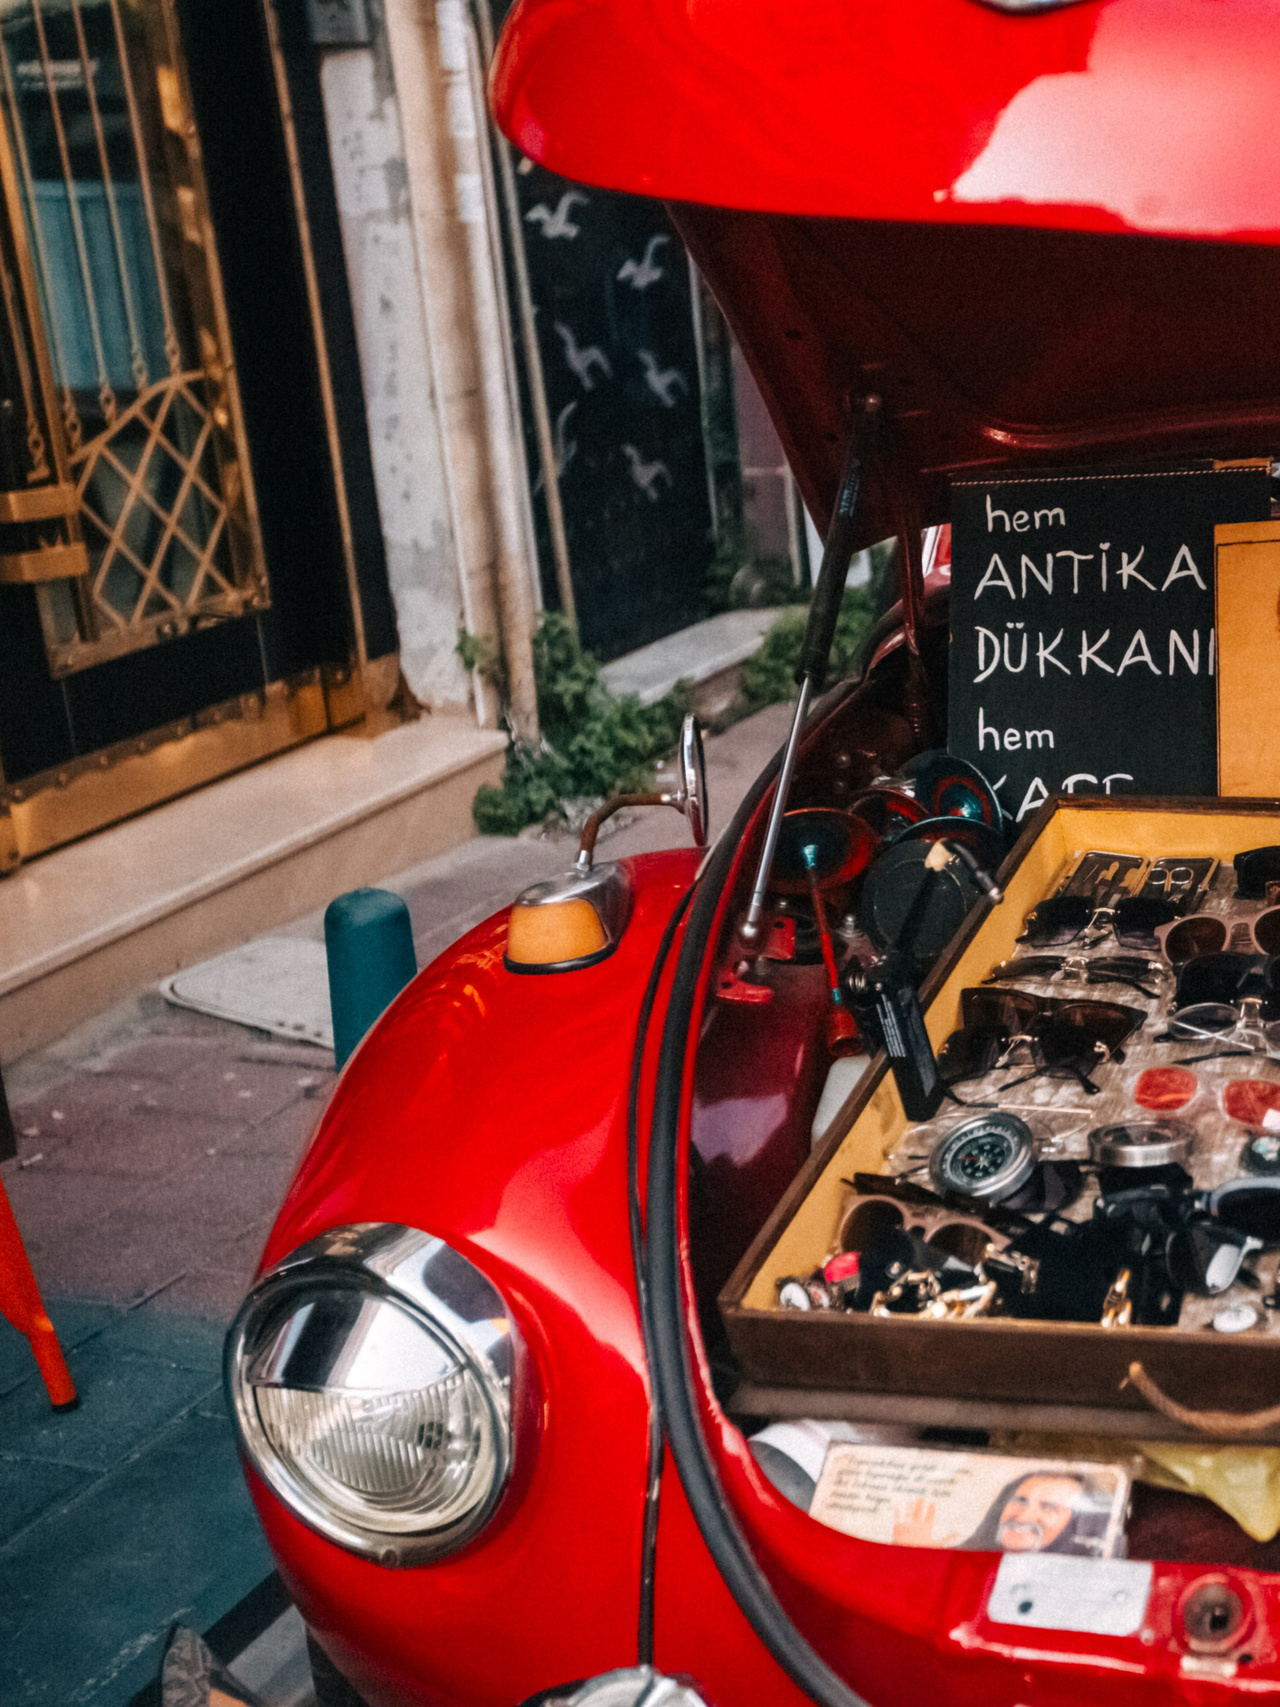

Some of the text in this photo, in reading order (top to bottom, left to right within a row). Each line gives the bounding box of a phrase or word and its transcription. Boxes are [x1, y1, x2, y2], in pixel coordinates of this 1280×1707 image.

[986, 494, 1066, 532] hem
[974, 542, 1207, 600] ANTİKA
[972, 622, 1215, 683] DÜKKANI
[978, 707, 1055, 751] hem
